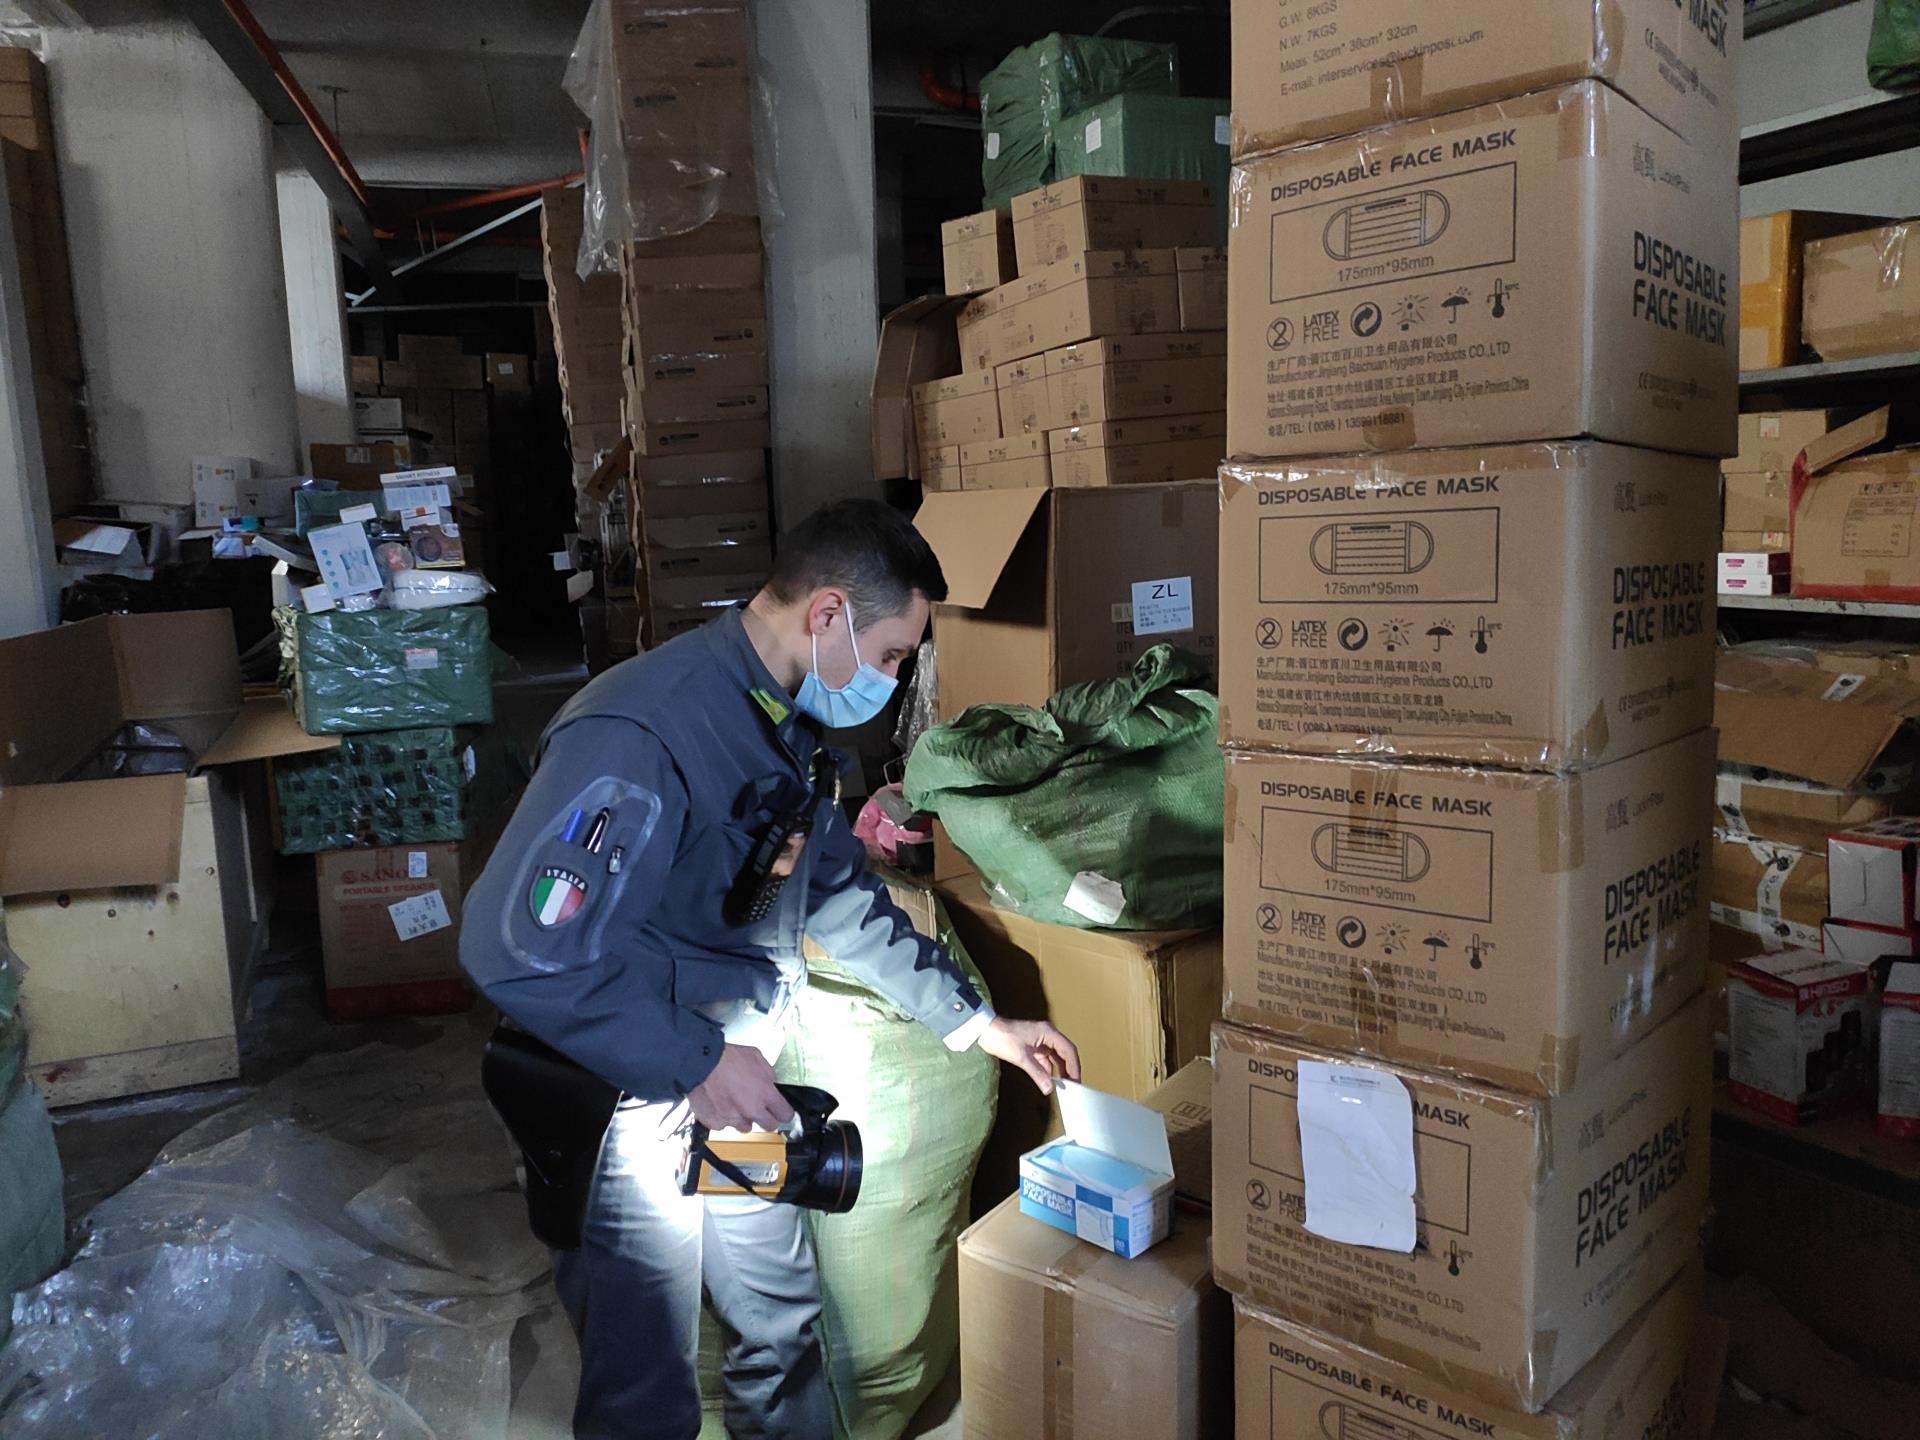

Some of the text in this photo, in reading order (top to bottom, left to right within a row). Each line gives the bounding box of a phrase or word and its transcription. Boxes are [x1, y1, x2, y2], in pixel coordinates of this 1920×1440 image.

[1307, 22, 1337, 42] 7KGS
[1386, 24, 1418, 41] 32cm
[1271, 129, 1517, 202] DISPOSABLE FACE MASK
[1634, 231, 1726, 307] DISPOSABLE
[1303, 310, 1340, 328] LATEX
[1633, 279, 1726, 348] FACE MASK
[1303, 325, 1340, 344] FREE
[1258, 475, 1500, 506] DISPOSABLE FACE MASK
[1151, 583, 1179, 600] ZL
[1613, 561, 1705, 605] DISPOSABLE
[1291, 620, 1328, 633] LATEX
[1291, 634, 1328, 648] FREE
[1612, 600, 1704, 650] FACE MASK
[1261, 781, 1493, 817] DISPOSABLE FACE MASK
[546, 868, 586, 891] ITALIA
[1605, 840, 1700, 921] DISPOSABLE
[1291, 909, 1326, 928] LATEX
[1291, 924, 1326, 942] FREE
[1604, 906, 1650, 965] FACE
[1656, 880, 1699, 933] MASK
[1248, 1059, 1298, 1085] DISPO
[1413, 1099, 1470, 1130] MASK
[1578, 1106, 1691, 1226] DISPOSABLE
[1279, 1189, 1305, 1207] LATE
[1576, 1195, 1629, 1269] FACE
[1638, 1152, 1688, 1215] MASK
[1268, 1342, 1496, 1438] DISPOSABLE FACE MASK
